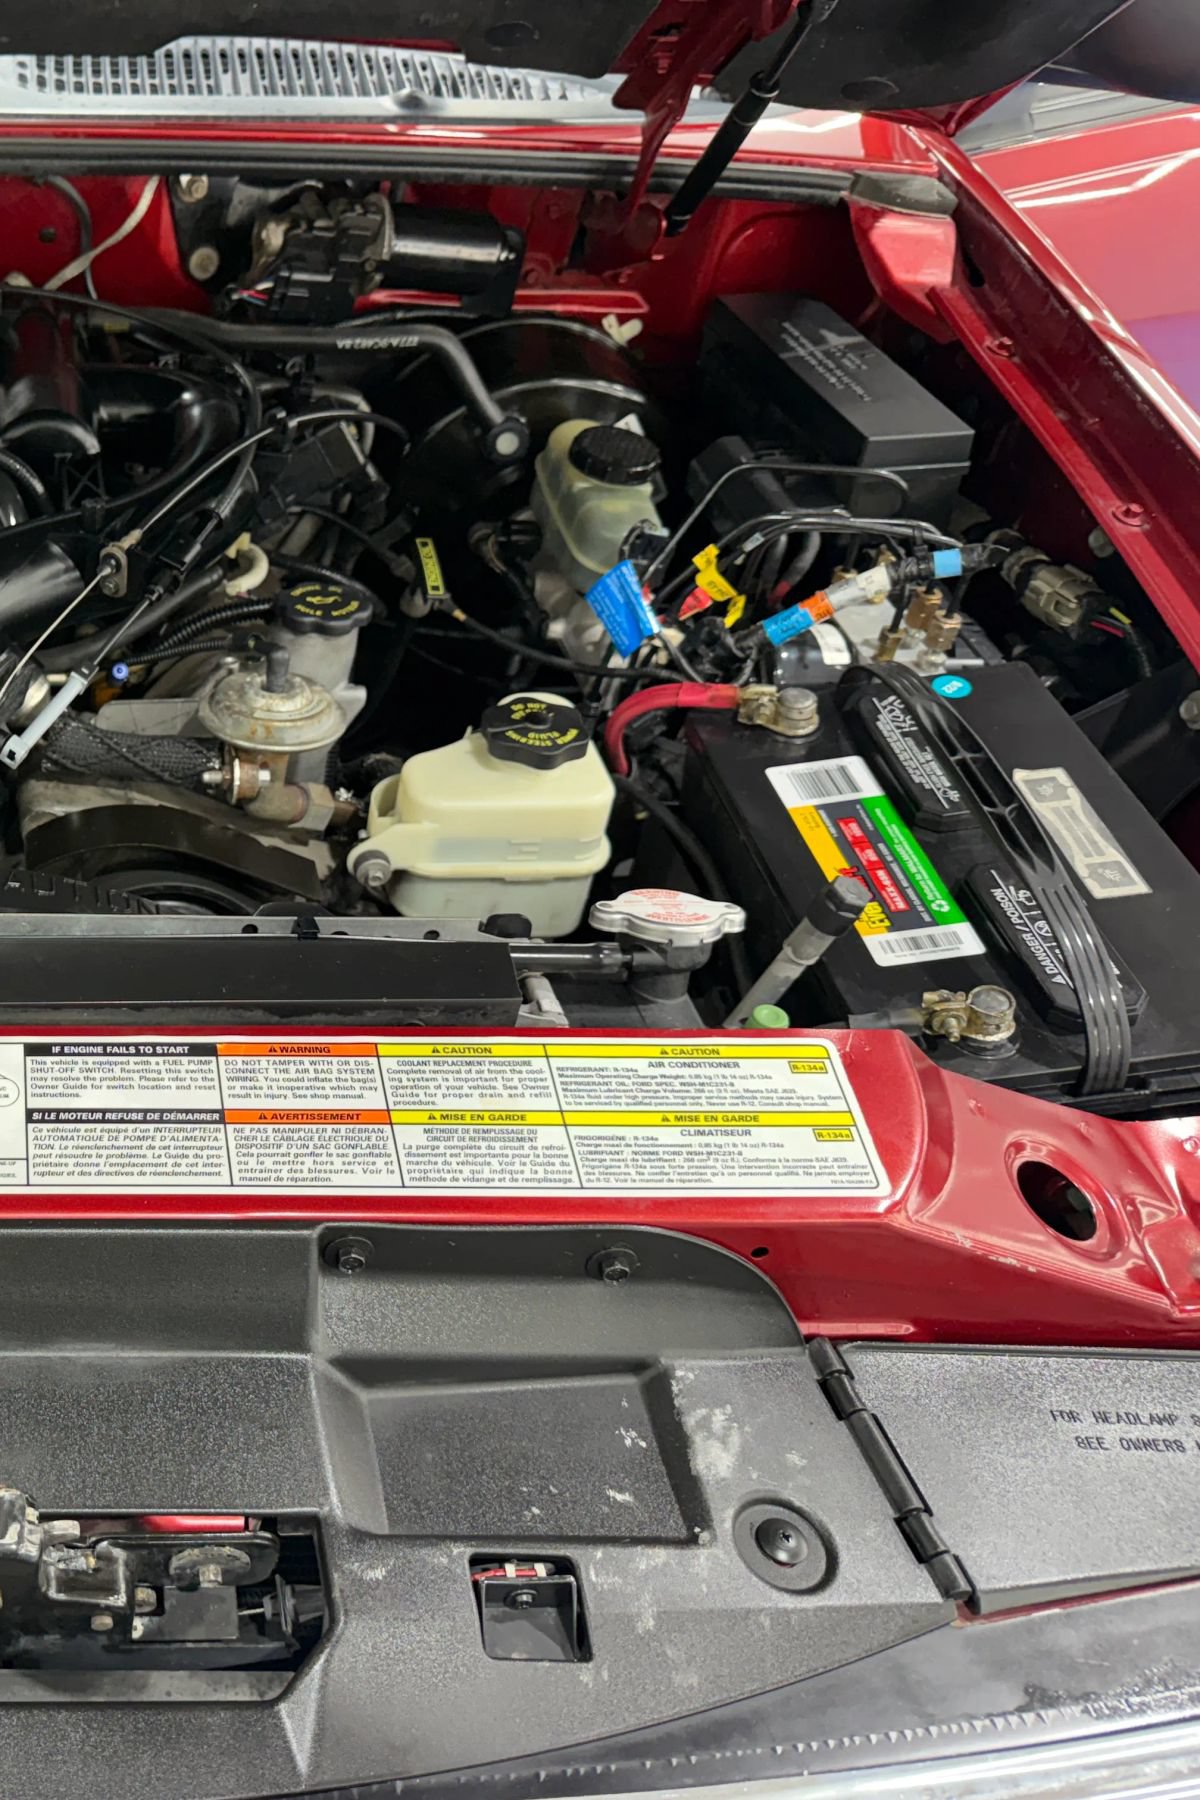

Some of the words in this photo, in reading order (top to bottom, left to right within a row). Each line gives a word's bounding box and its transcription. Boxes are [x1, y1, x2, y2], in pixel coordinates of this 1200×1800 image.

[991, 888, 1024, 924] POISON
[1022, 933, 1059, 974] DANGER
[671, 1048, 720, 1056] CAUTION
[668, 1061, 740, 1069] CONDITIONER
[792, 1063, 825, 1071] R-134a
[163, 1111, 219, 1120] DÉMARRER
[680, 1129, 752, 1137] CLIMATISEUR
[817, 1131, 850, 1139] R-134a
[1050, 1410, 1083, 1424] FOR
[1092, 1410, 1178, 1426] HEADLAMP
